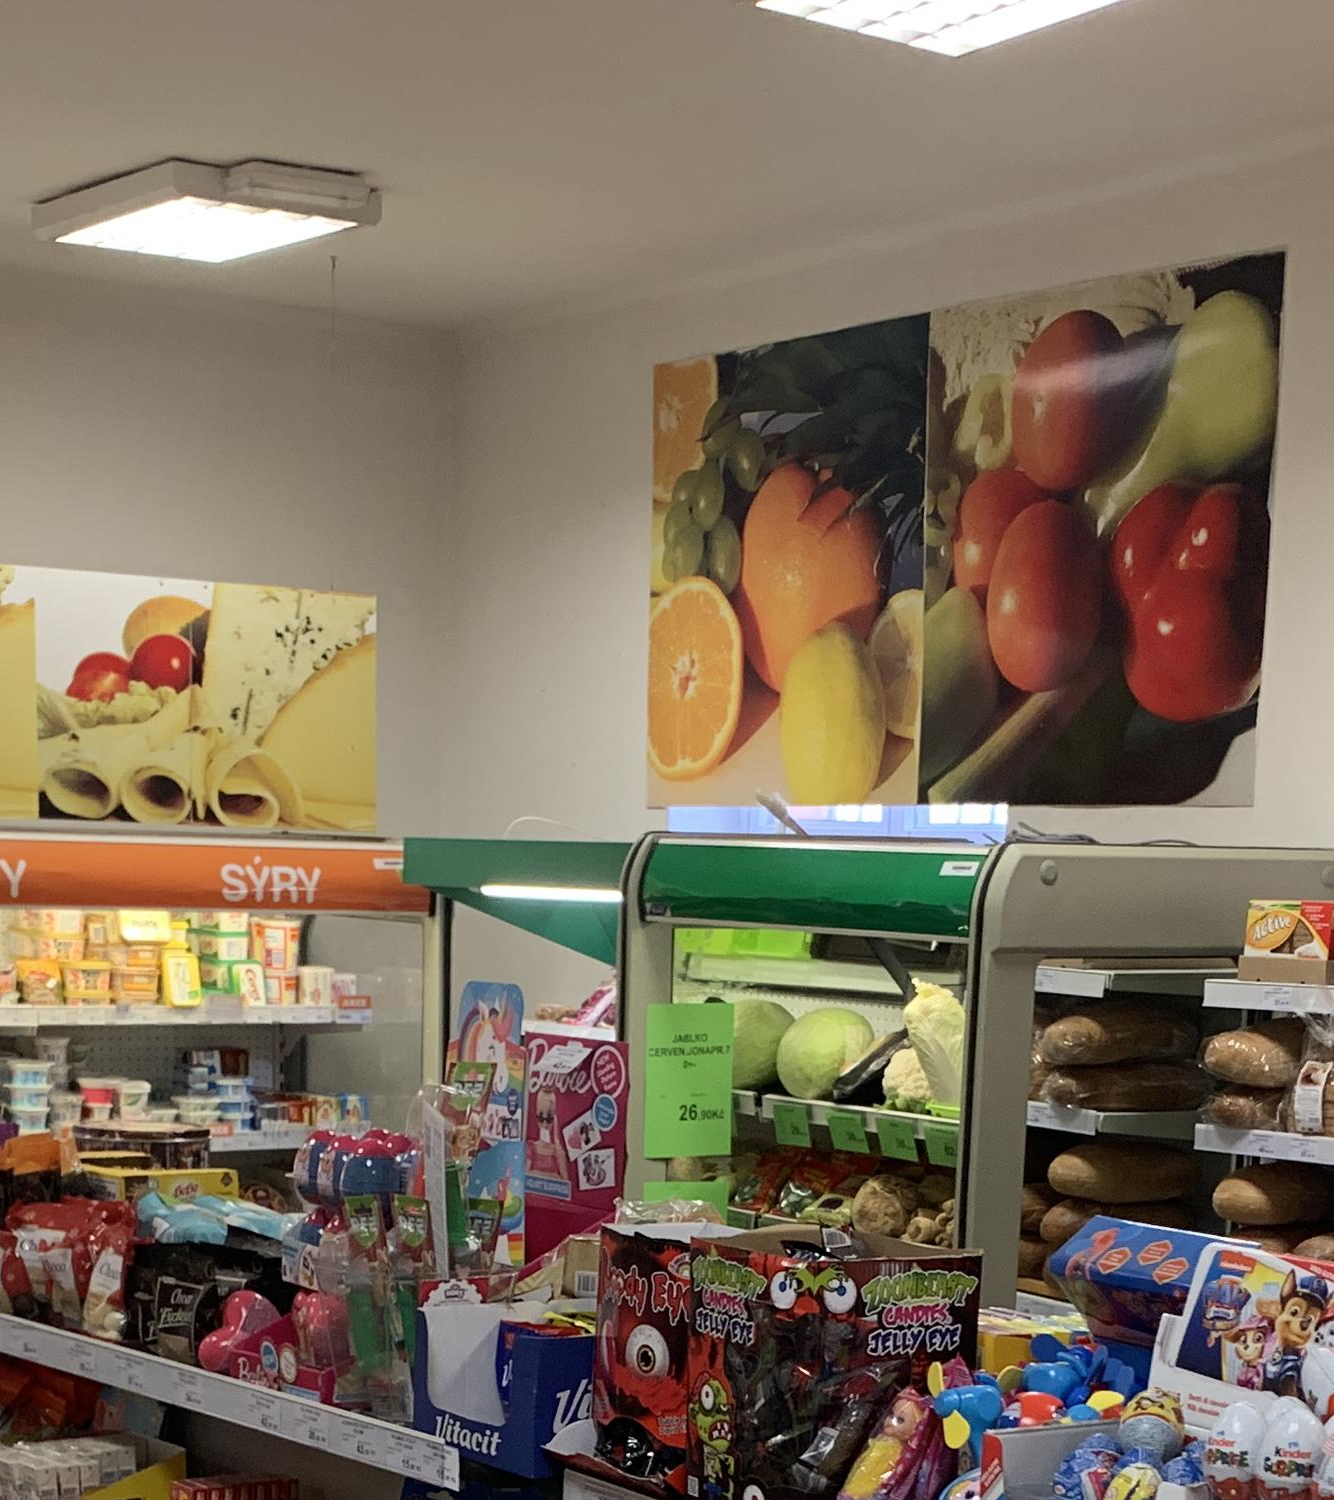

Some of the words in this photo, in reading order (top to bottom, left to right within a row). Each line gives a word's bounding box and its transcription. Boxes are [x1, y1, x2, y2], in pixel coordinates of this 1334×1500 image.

[221, 864, 321, 902] SÝRY
[1251, 915, 1292, 941] Active
[672, 1033, 708, 1043] JABLKO
[695, 1308, 730, 1338] JELLY
[730, 1317, 757, 1346] EYE
[882, 1304, 949, 1327] CANDIES
[868, 1328, 925, 1356] JELLY
[926, 1325, 962, 1352] EYE
[435, 1414, 502, 1456] Vitacit
